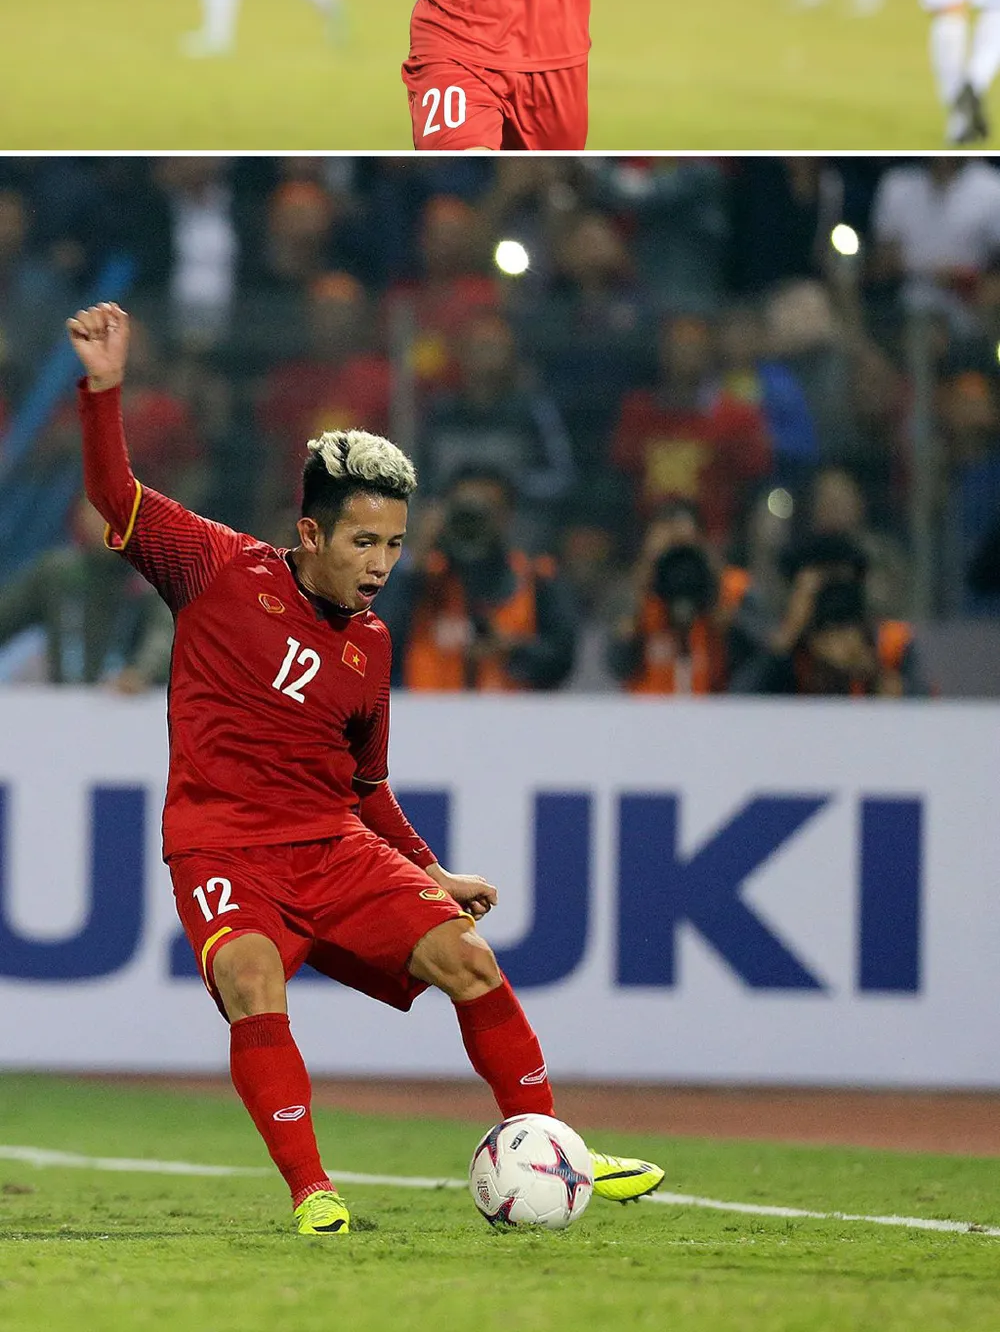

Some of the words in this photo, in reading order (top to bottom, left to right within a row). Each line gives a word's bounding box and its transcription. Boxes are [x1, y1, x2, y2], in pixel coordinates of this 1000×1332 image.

[421, 85, 466, 138] 20
[272, 636, 321, 704] 12
[0, 783, 925, 994] UUKI
[193, 877, 240, 922] 12
